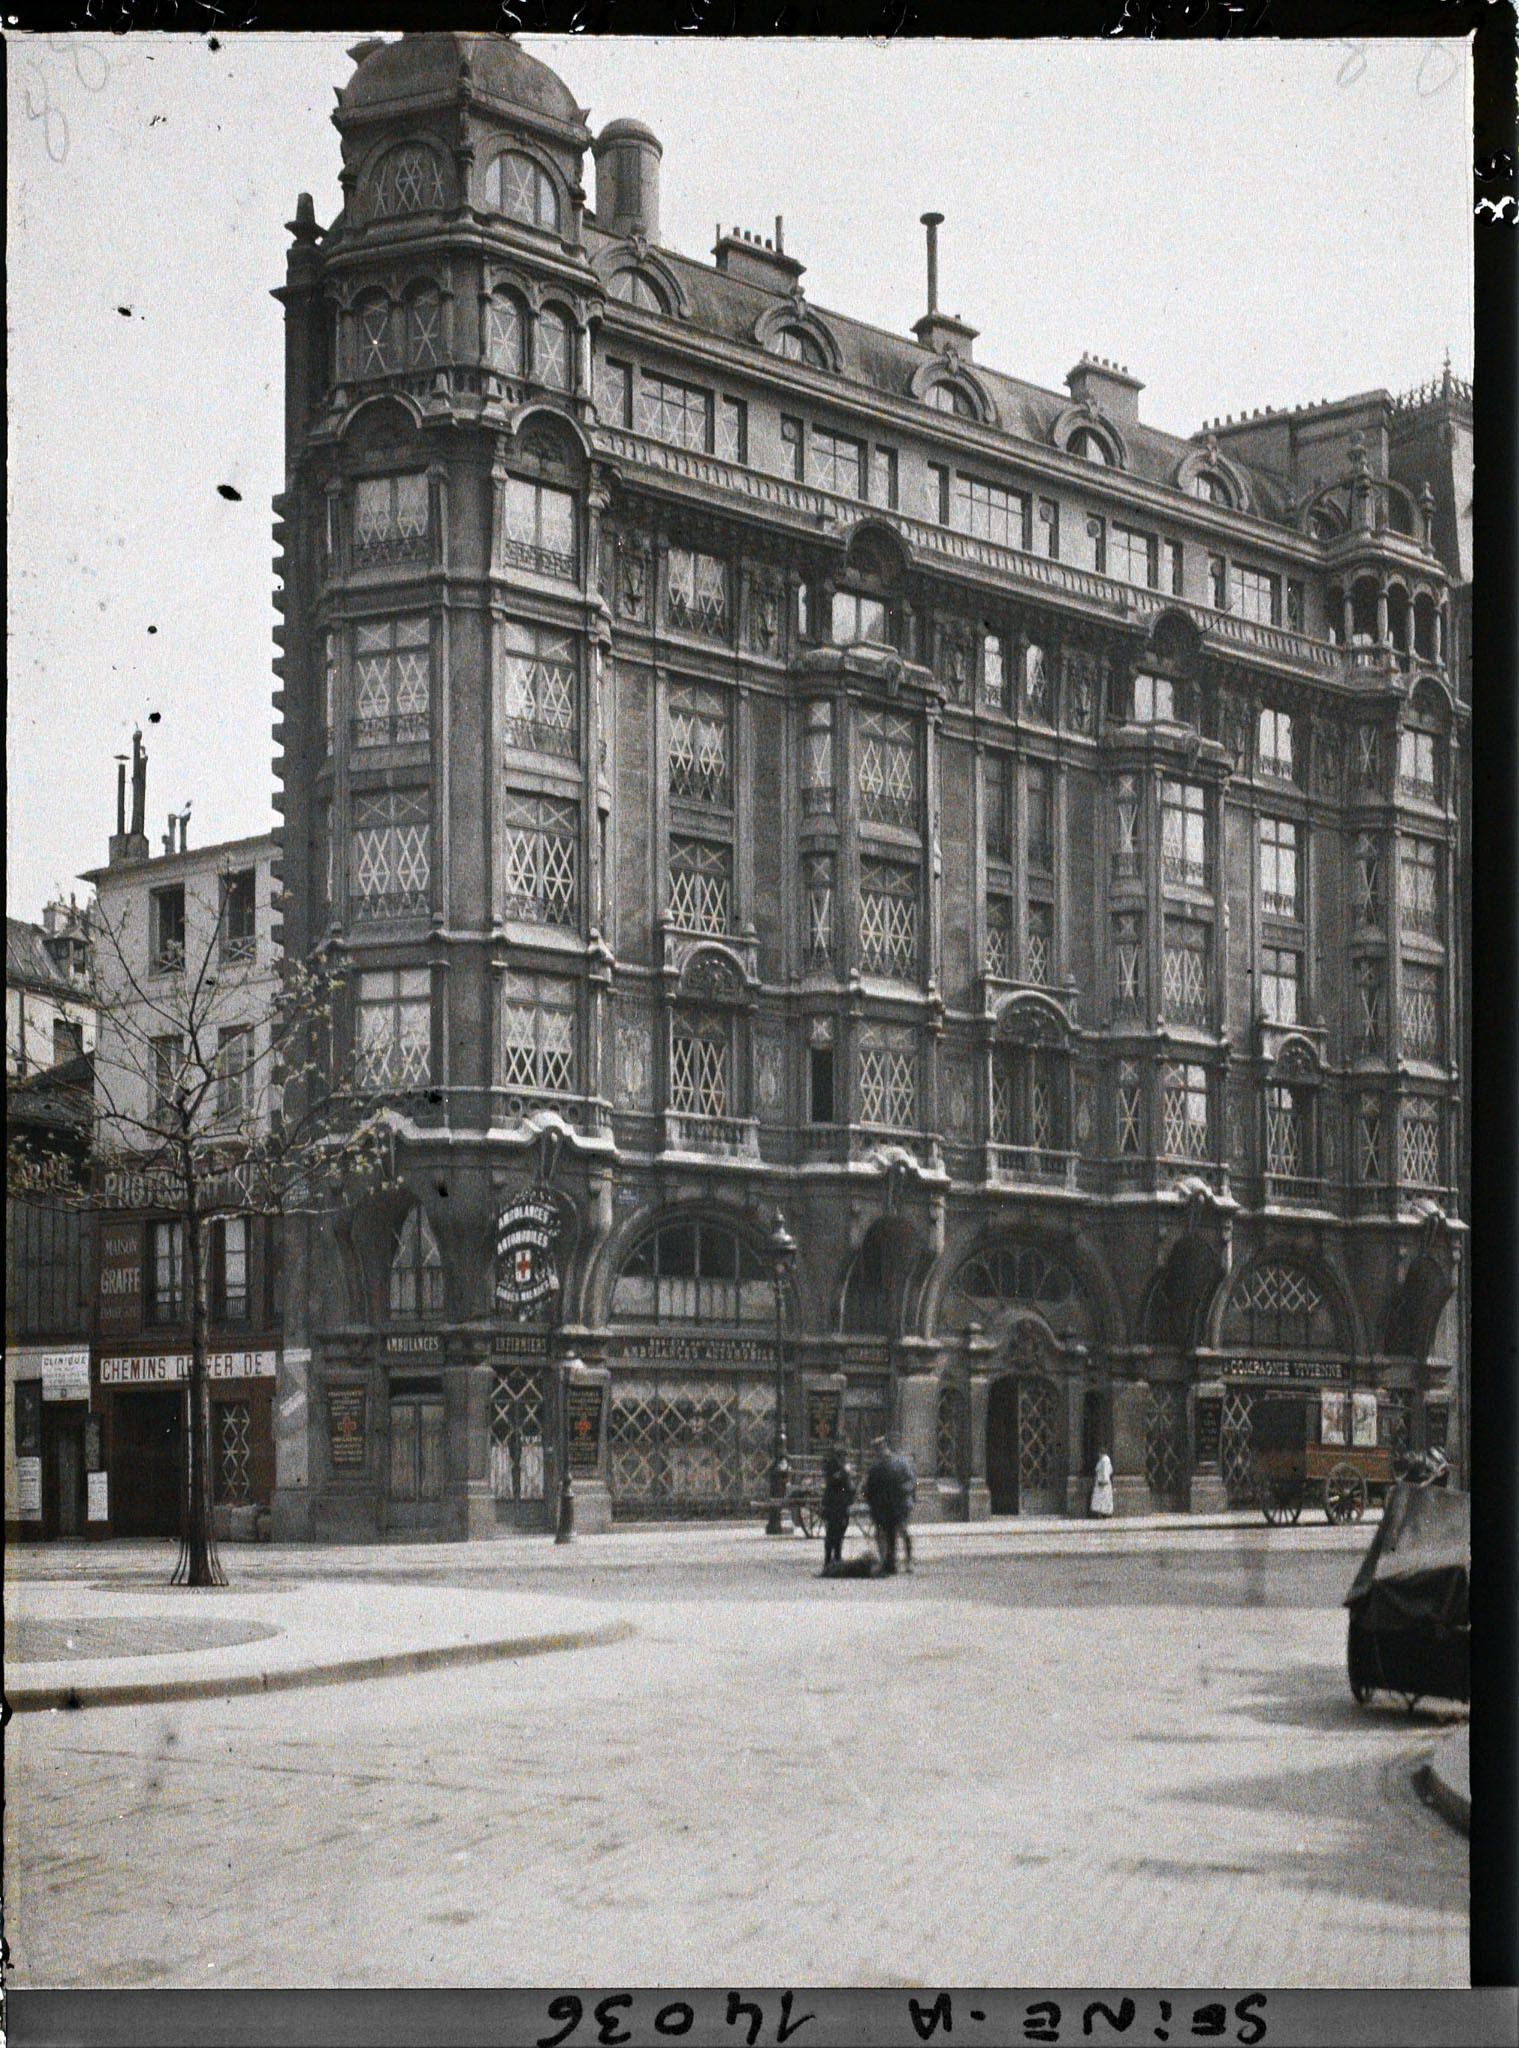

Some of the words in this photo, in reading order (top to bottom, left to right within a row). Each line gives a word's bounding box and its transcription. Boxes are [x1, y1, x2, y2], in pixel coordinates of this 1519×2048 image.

[100, 1266, 140, 1295] GRAFFE
[386, 1335, 439, 1353] AMBULANCES
[43, 1355, 87, 1367] CLINIQUE
[102, 1357, 166, 1382] CHEMINS
[243, 1353, 262, 1376] DE
[1230, 1359, 1290, 1376] COMPAGNIE
[1293, 1361, 1342, 1378] VIVIENNE
